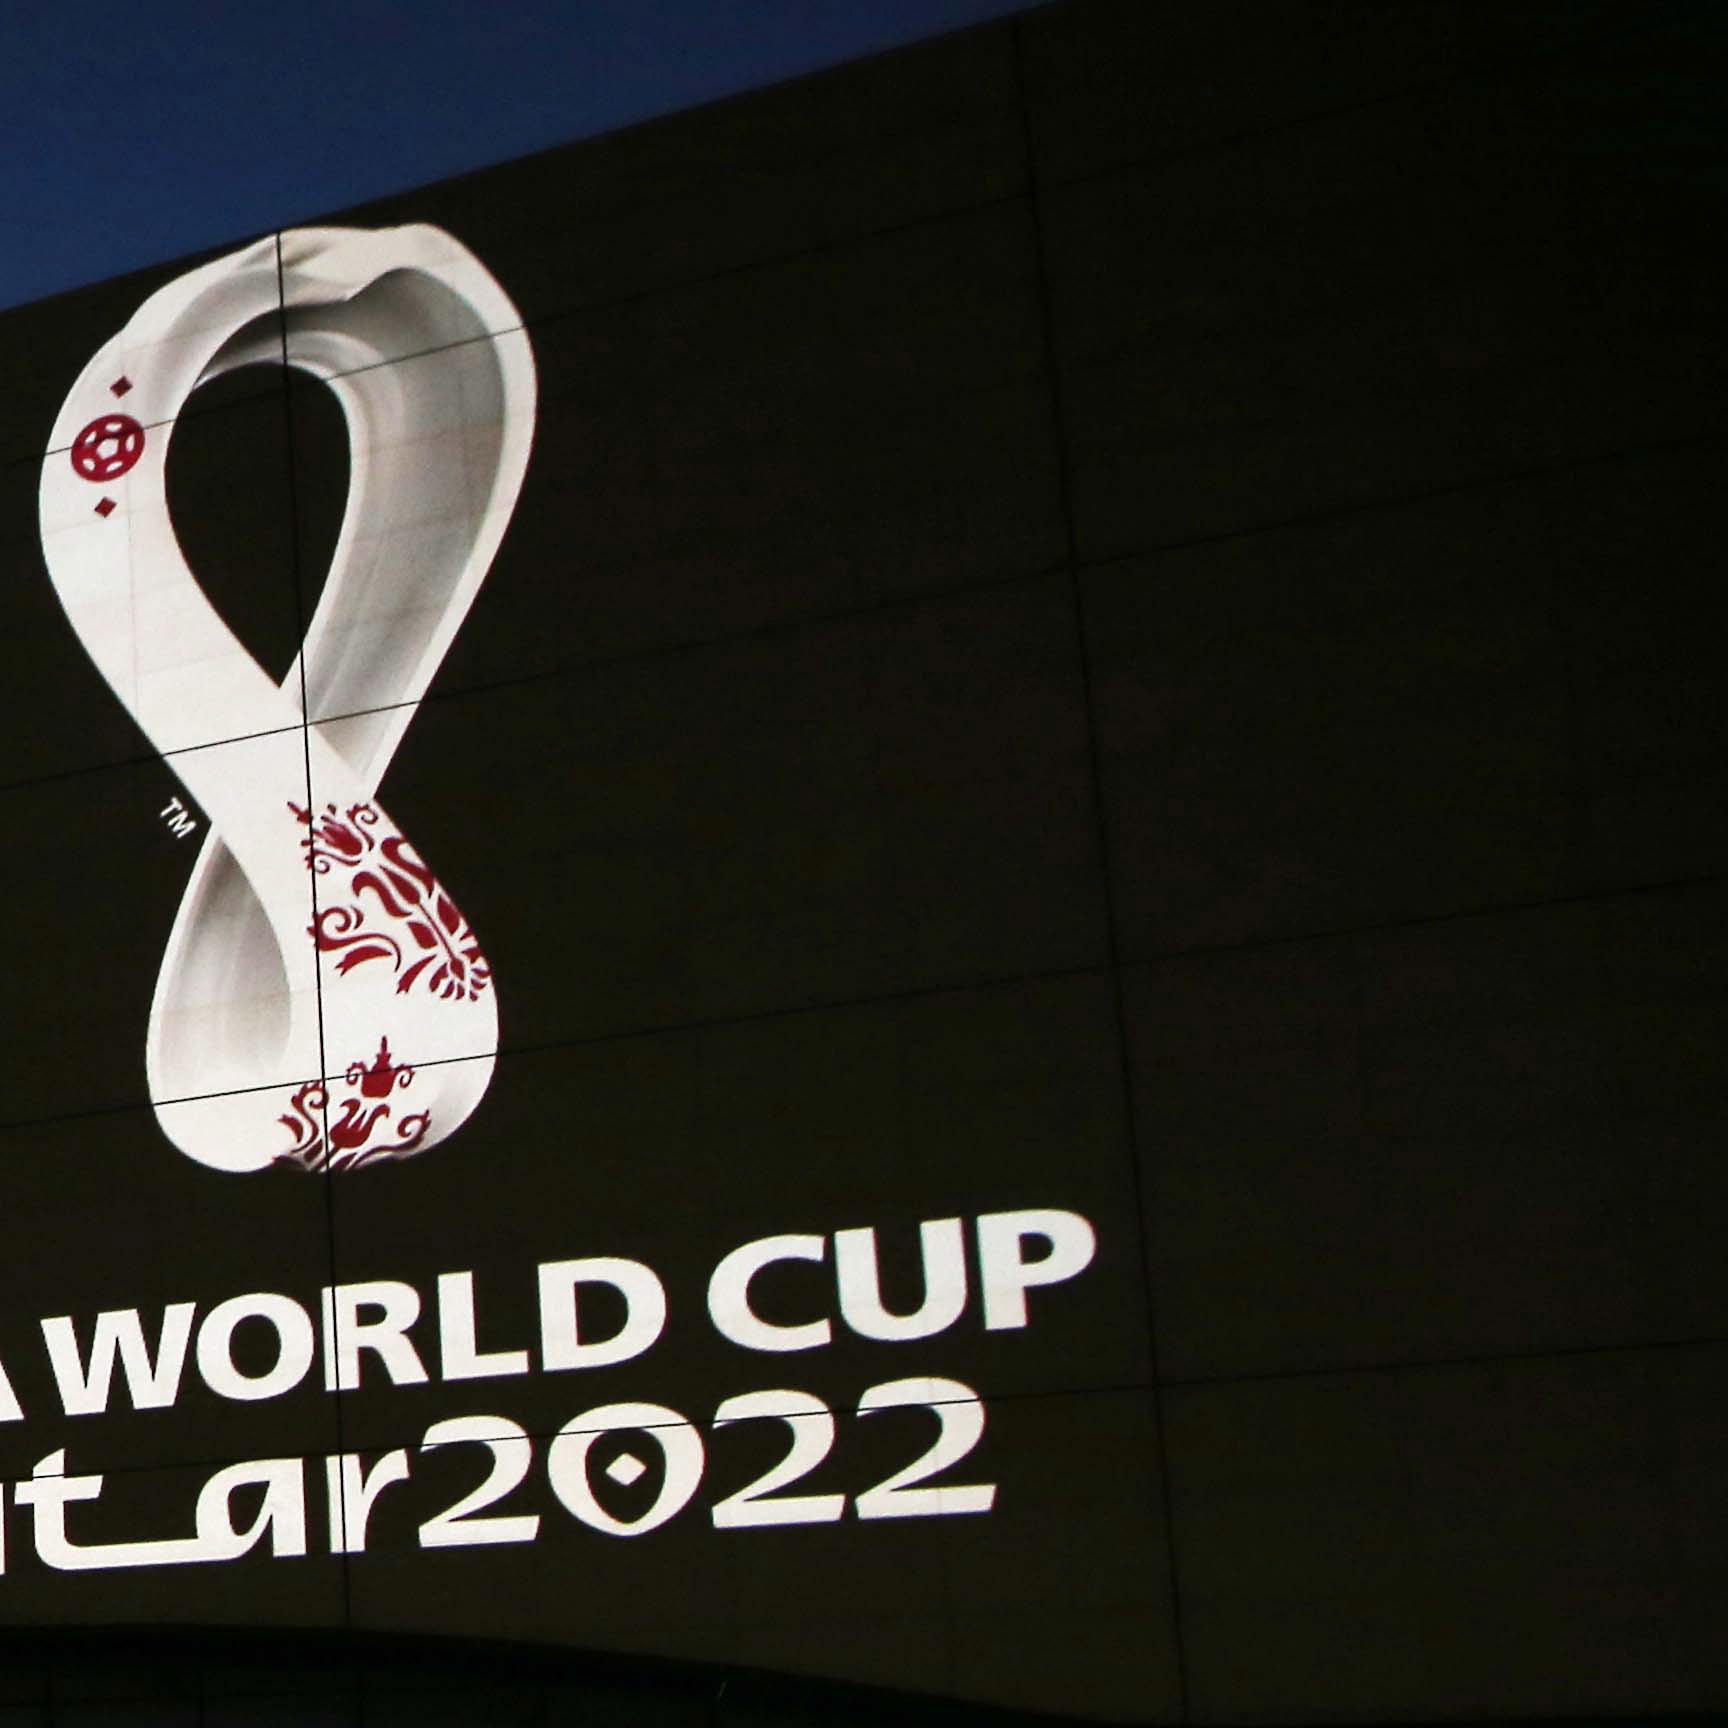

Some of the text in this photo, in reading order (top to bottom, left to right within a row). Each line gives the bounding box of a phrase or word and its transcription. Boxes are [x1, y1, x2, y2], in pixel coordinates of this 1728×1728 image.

[159, 796, 197, 839] TM
[40, 1256, 667, 1416] WORLD
[707, 1209, 1096, 1352] CUP
